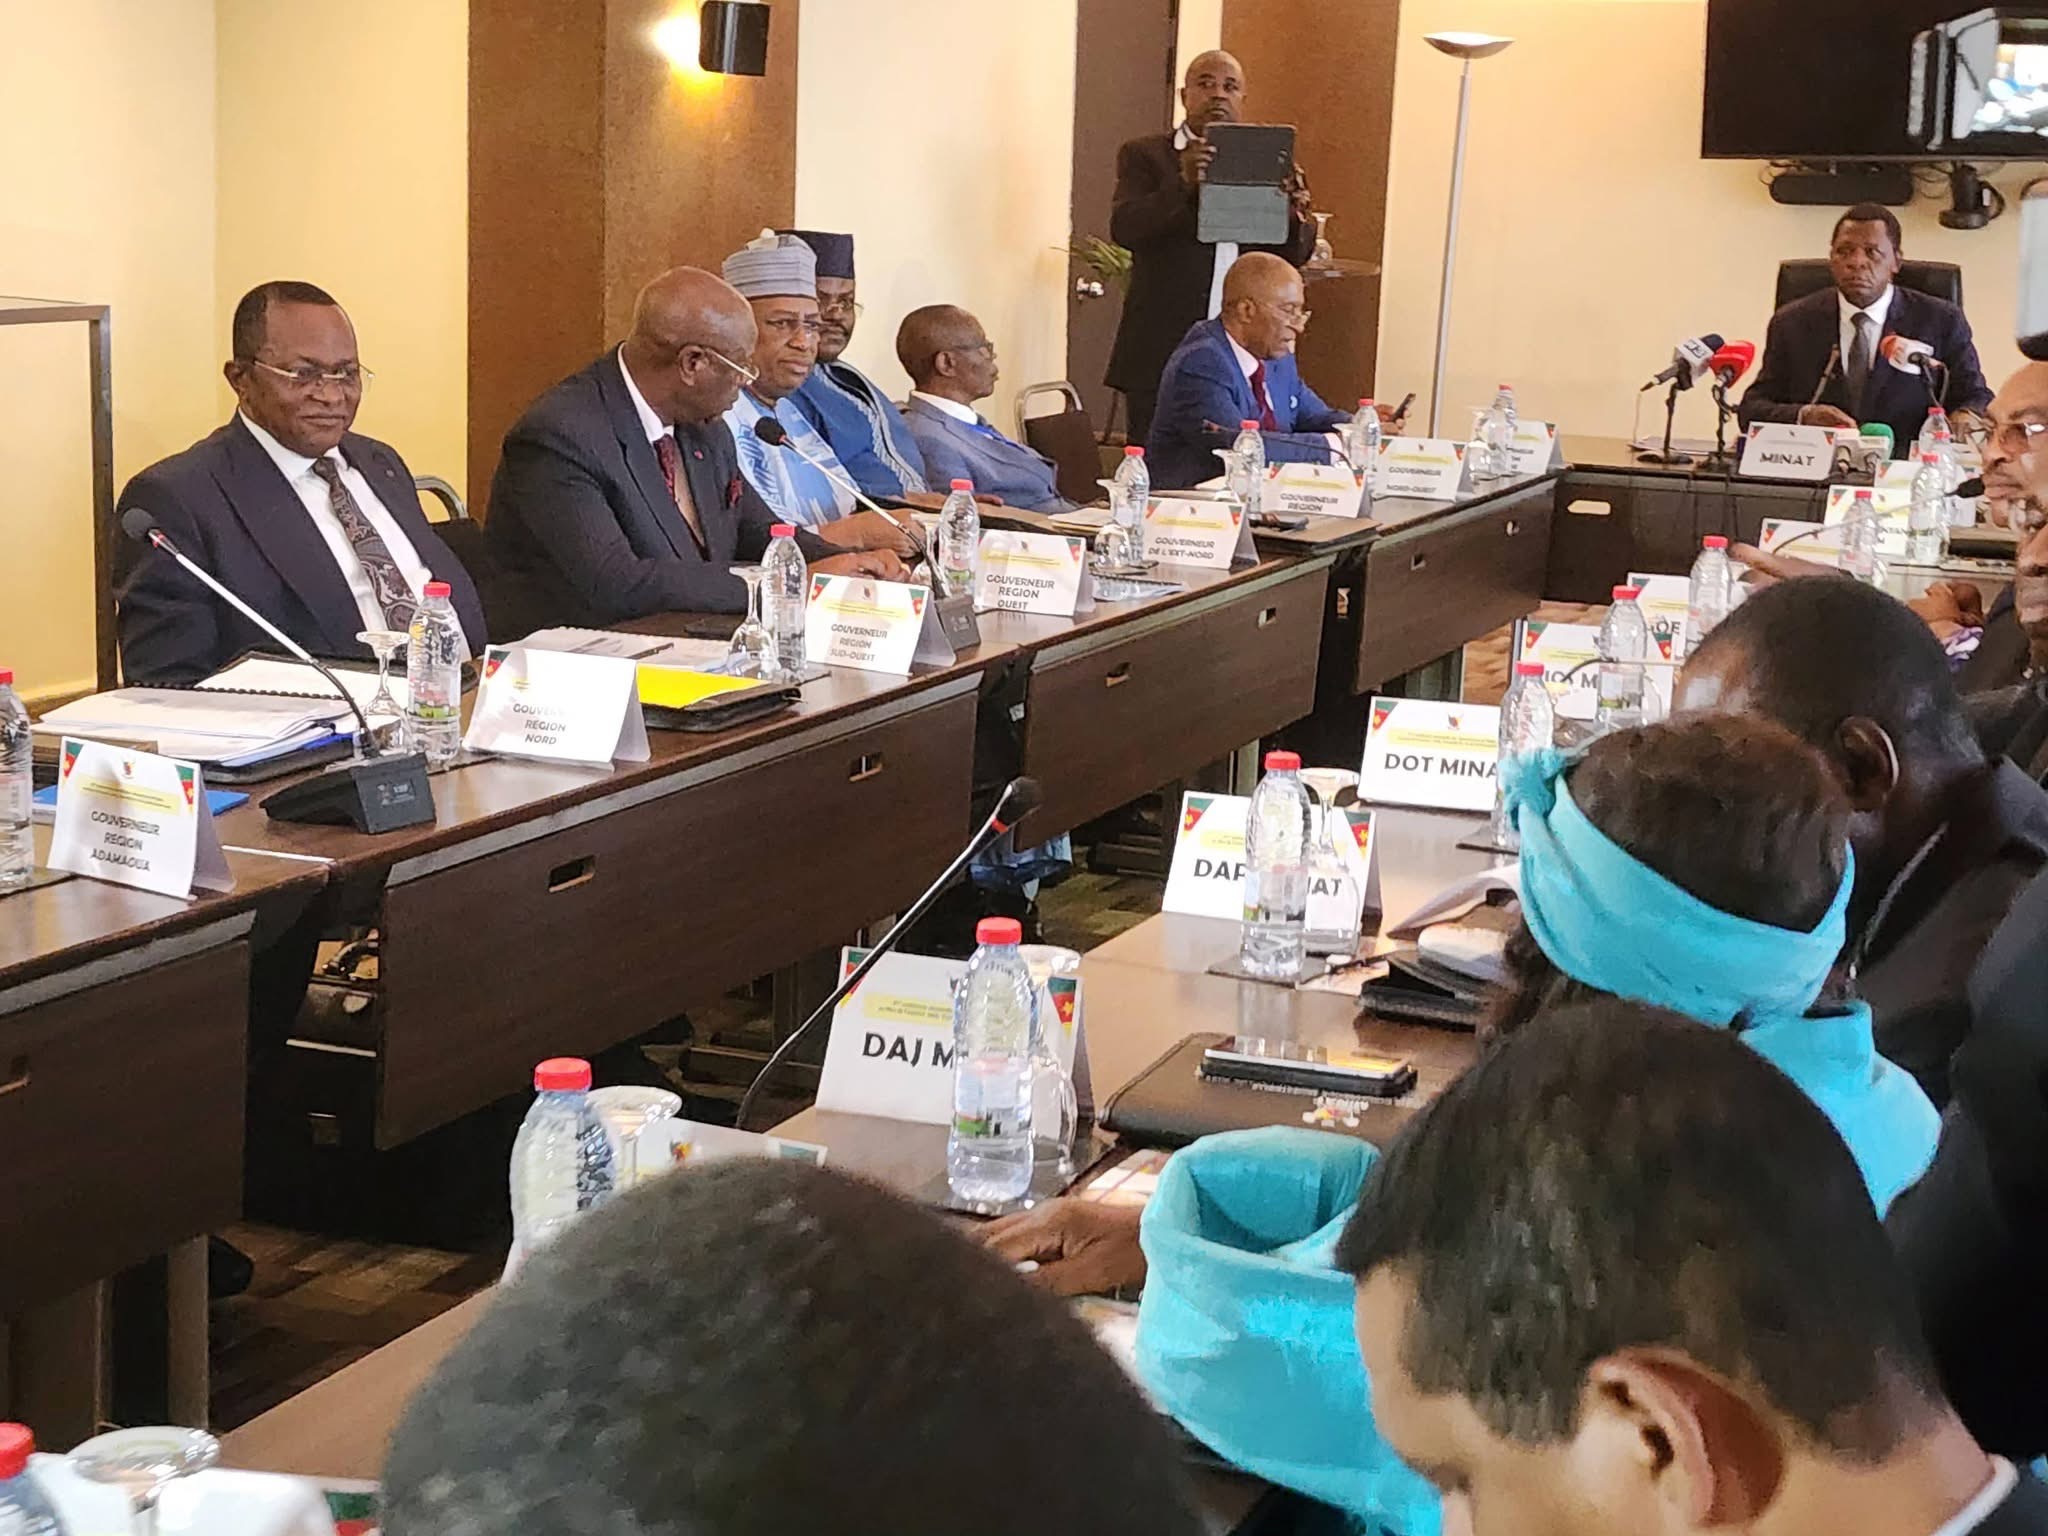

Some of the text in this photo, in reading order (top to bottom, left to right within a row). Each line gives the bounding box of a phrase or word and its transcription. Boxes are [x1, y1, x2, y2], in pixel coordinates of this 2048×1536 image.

[1760, 452, 1815, 466] MINAT
[1155, 537, 1215, 548] GOUVERNEUR
[986, 574, 1055, 589] GOUVERNEUR
[999, 587, 1040, 599] REGION
[831, 624, 888, 639] GOUVERNEUR
[840, 638, 872, 648] REGION
[525, 720, 566, 732] REGION
[525, 734, 557, 744] NORD
[1384, 753, 1497, 778] DOT MINA
[91, 811, 160, 835] GOUVERNEUR
[104, 832, 143, 850] REGION
[862, 1032, 923, 1067] DAJ
